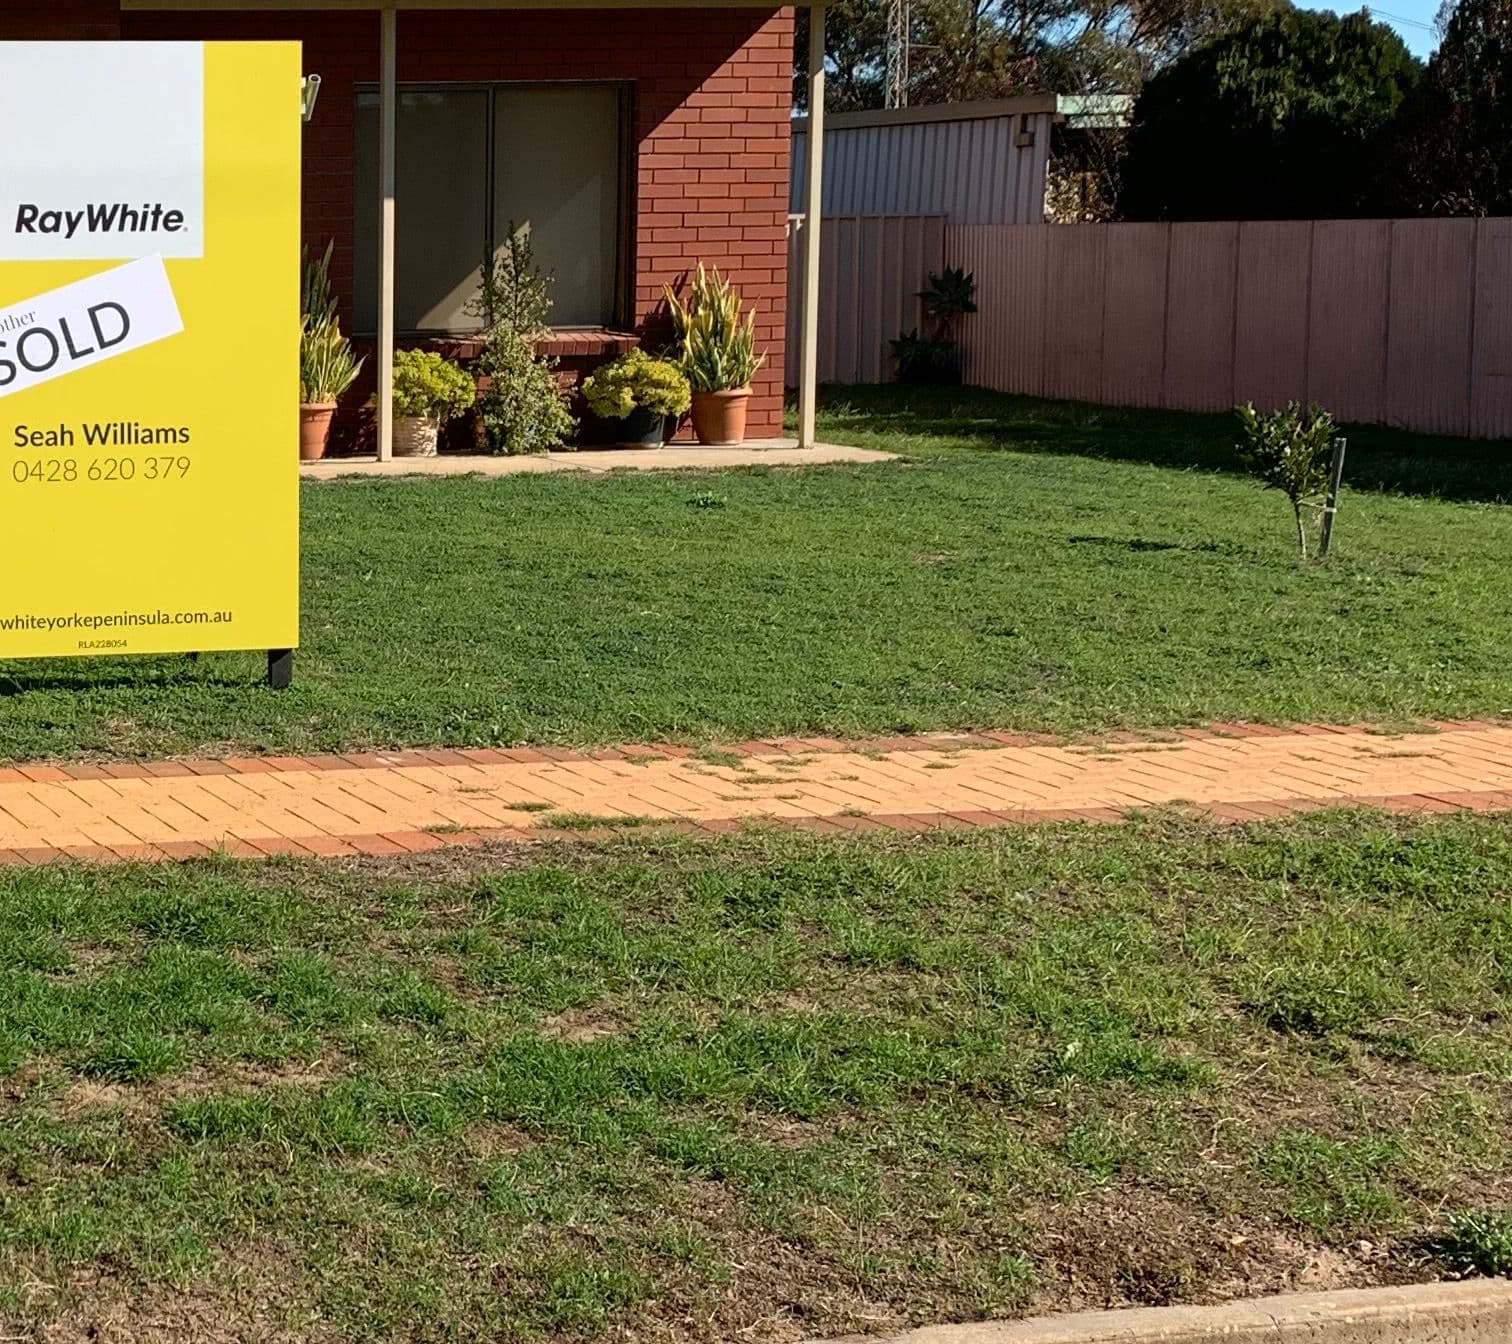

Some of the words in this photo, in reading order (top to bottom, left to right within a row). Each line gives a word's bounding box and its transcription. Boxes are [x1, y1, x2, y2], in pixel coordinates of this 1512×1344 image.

[14, 423, 75, 447] Seah
[82, 421, 190, 446] Williams
[13, 459, 78, 483] 0428
[88, 458, 136, 481] 620
[144, 456, 191, 480] 379
